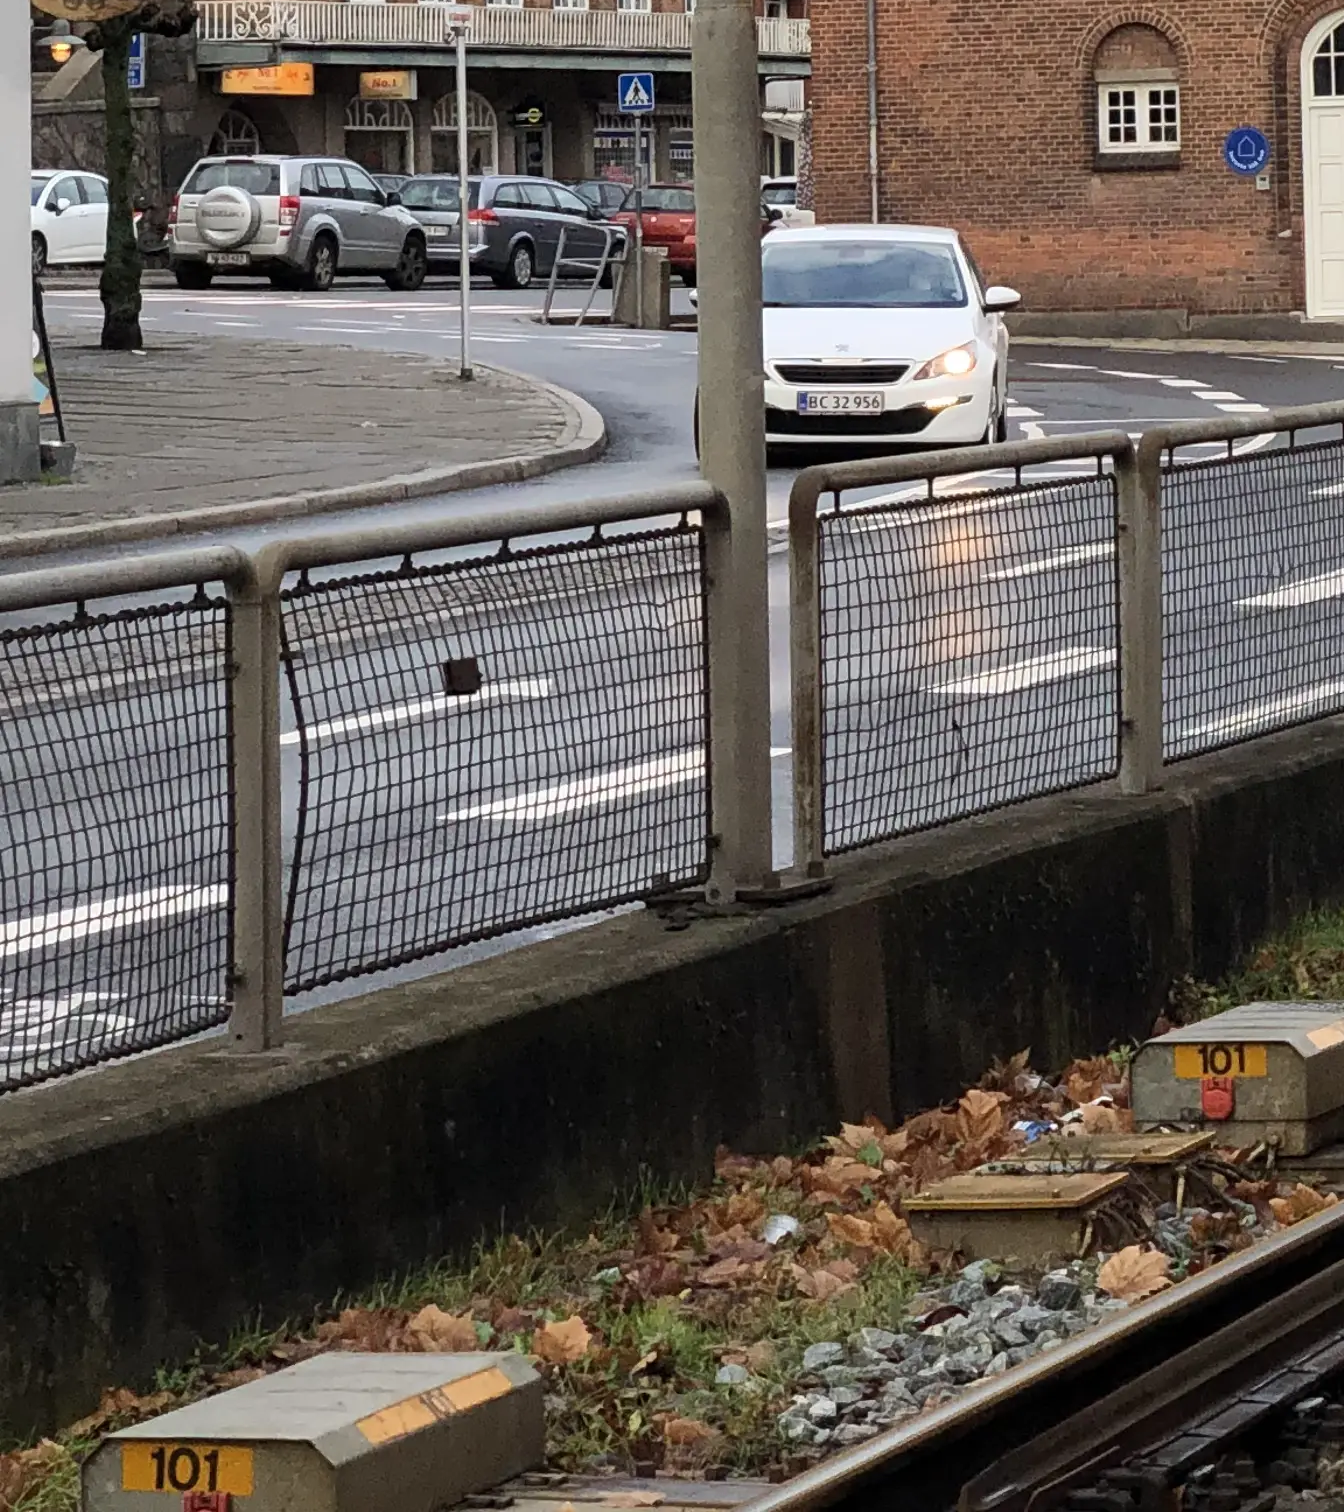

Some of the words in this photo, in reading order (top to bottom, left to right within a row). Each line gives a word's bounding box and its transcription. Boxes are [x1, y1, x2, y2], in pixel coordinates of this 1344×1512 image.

[808, 394, 829, 409] BC
[832, 394, 849, 409] 32
[855, 394, 881, 410] 956
[1198, 1043, 1246, 1076] 101
[150, 1447, 220, 1492] 101
